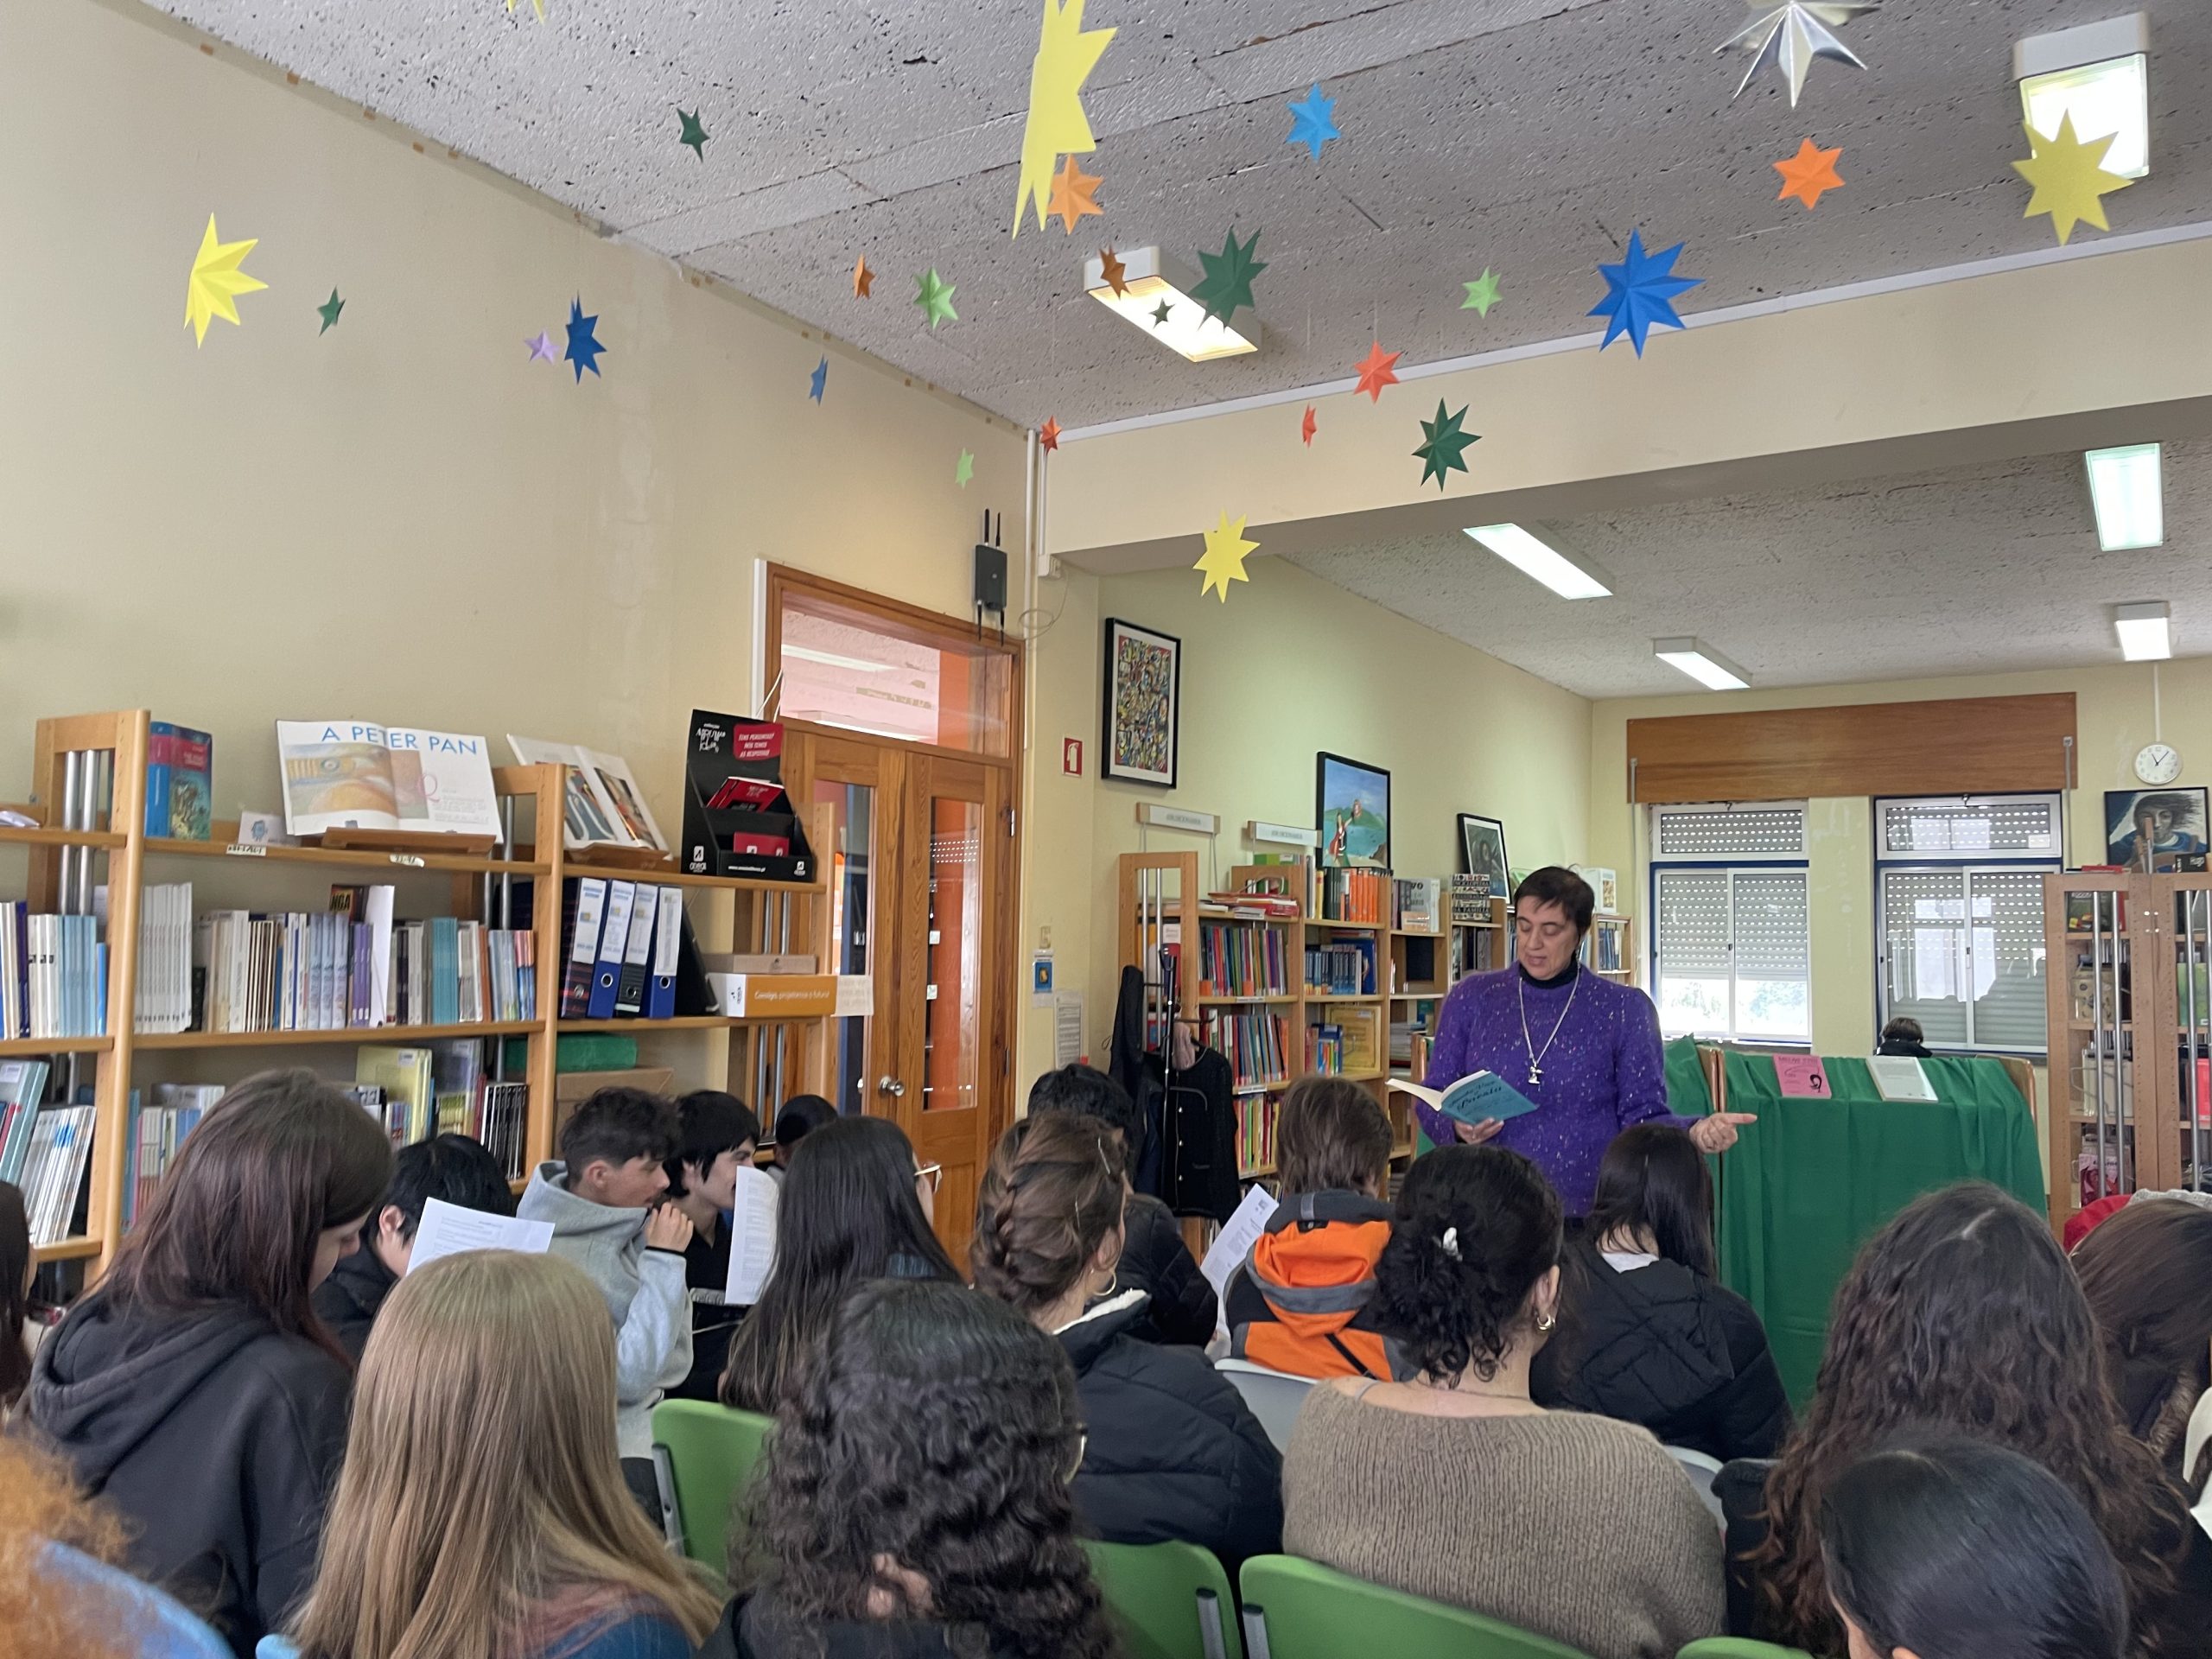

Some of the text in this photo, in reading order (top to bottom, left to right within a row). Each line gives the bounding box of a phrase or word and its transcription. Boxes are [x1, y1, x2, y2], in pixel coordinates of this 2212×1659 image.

[321, 726, 478, 755] A PETER PAN
